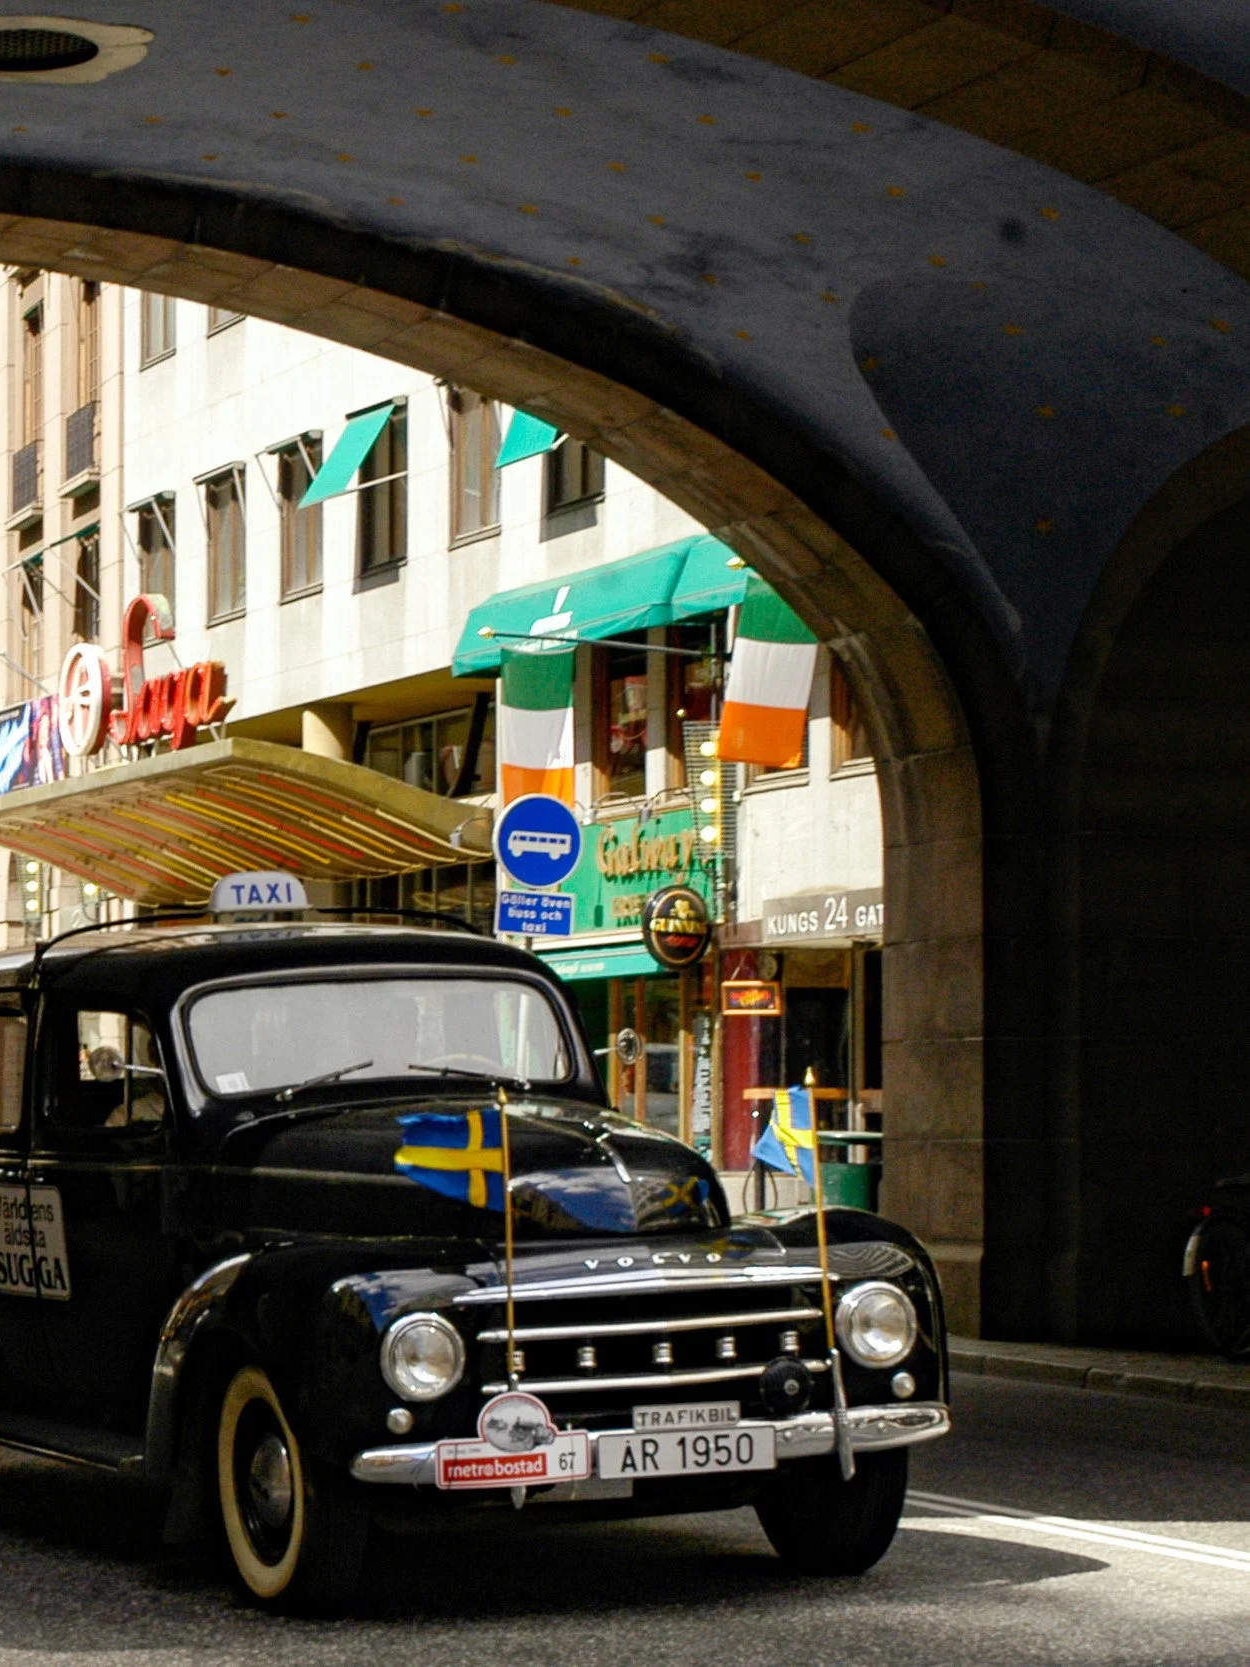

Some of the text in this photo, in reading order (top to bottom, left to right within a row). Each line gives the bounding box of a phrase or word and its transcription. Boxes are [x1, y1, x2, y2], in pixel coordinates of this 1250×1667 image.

[109, 593, 237, 751] Saga
[231, 882, 293, 904] TAXI
[766, 910, 819, 935] KUNGS
[824, 896, 848, 931] 24
[584, 1252, 722, 1270] VOLVO
[637, 1406, 737, 1426] TRAFIKBIL
[559, 1452, 576, 1471] 67
[677, 1433, 754, 1469] 1950
[448, 1457, 543, 1478] metrobostad
